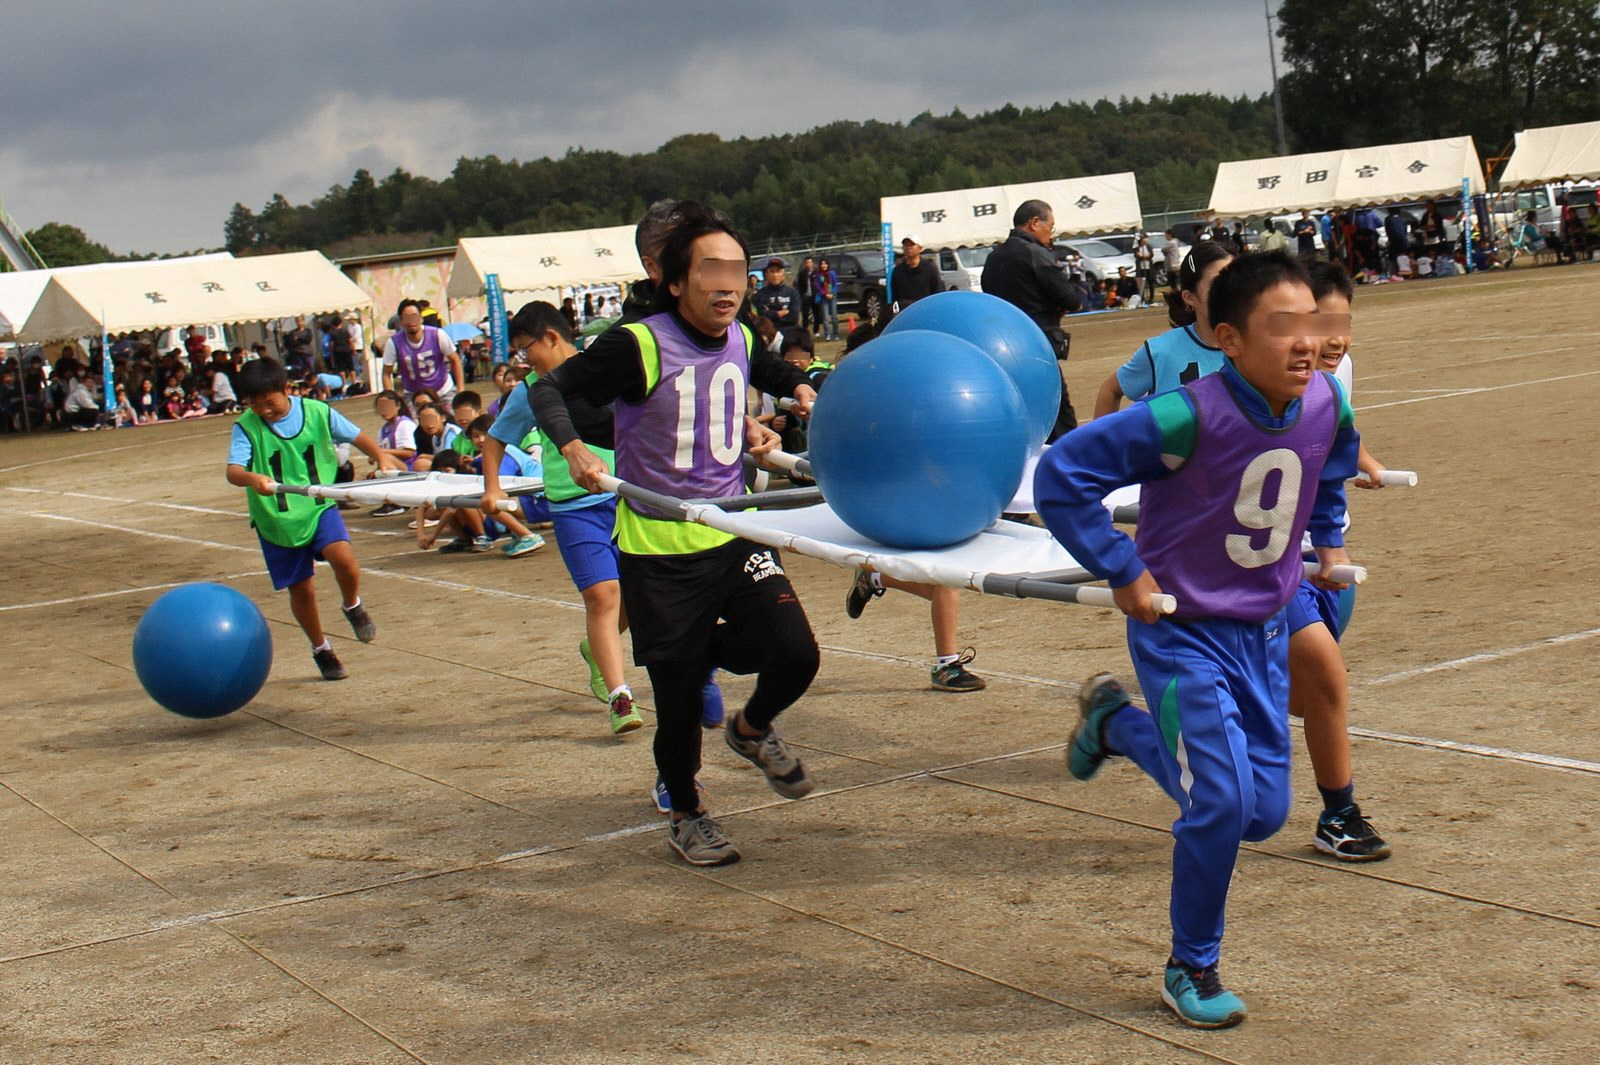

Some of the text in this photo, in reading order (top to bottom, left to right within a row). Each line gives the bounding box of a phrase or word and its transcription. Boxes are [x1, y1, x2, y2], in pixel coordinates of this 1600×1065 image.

[1257, 159, 1430, 190] 野田官舎
[921, 195, 1099, 224] 野田舎
[404, 350, 436, 380] 15
[675, 362, 745, 469] 10
[268, 444, 326, 513] 11
[1225, 448, 1303, 569] 9
